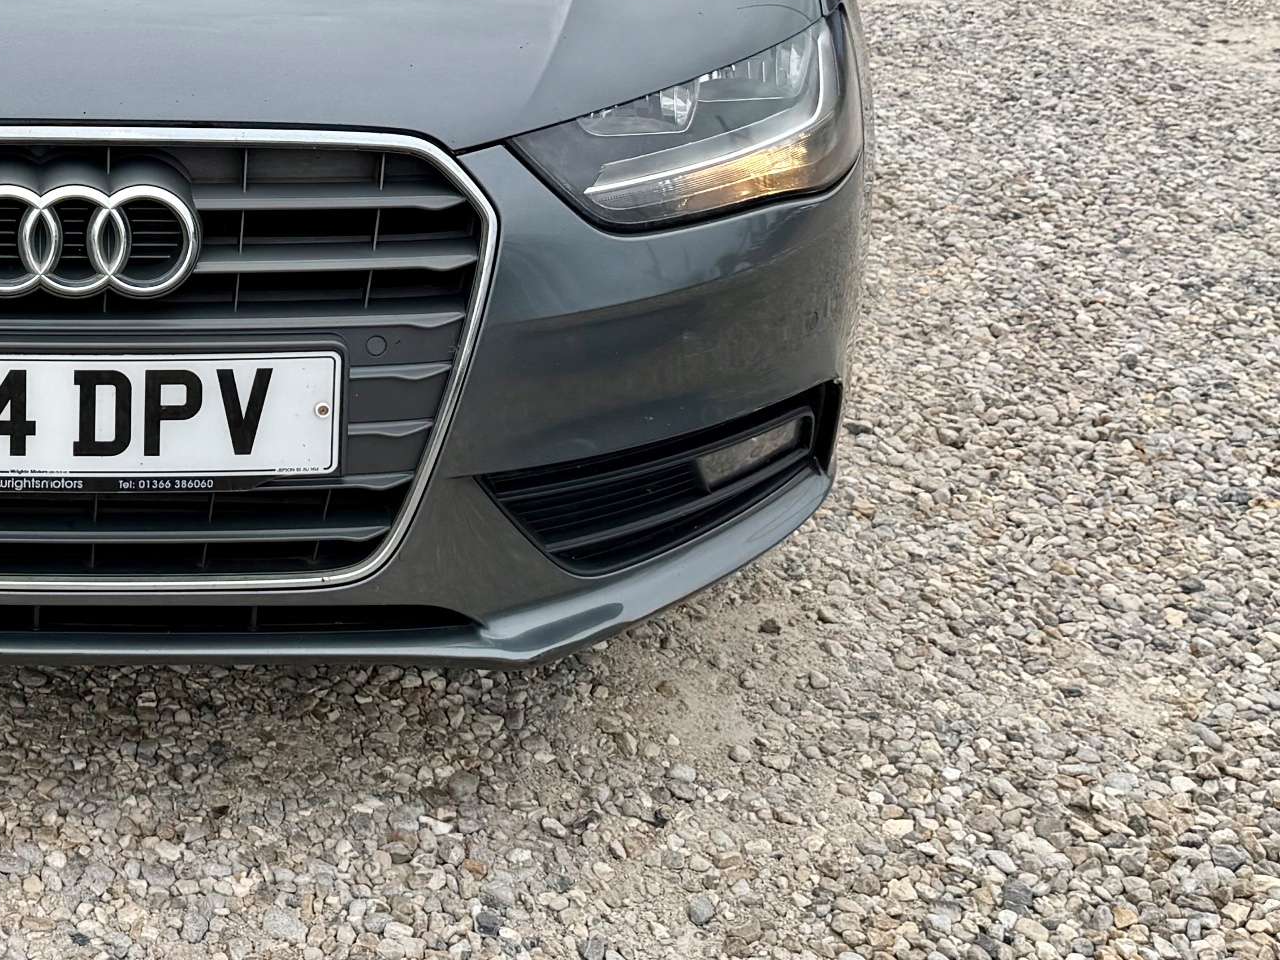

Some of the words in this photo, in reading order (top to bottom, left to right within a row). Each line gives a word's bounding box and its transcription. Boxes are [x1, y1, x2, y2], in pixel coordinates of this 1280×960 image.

[72, 367, 274, 457] DPV
[119, 479, 135, 489] Tel:
[138, 479, 171, 489] 01366
[174, 479, 214, 489] 386060
